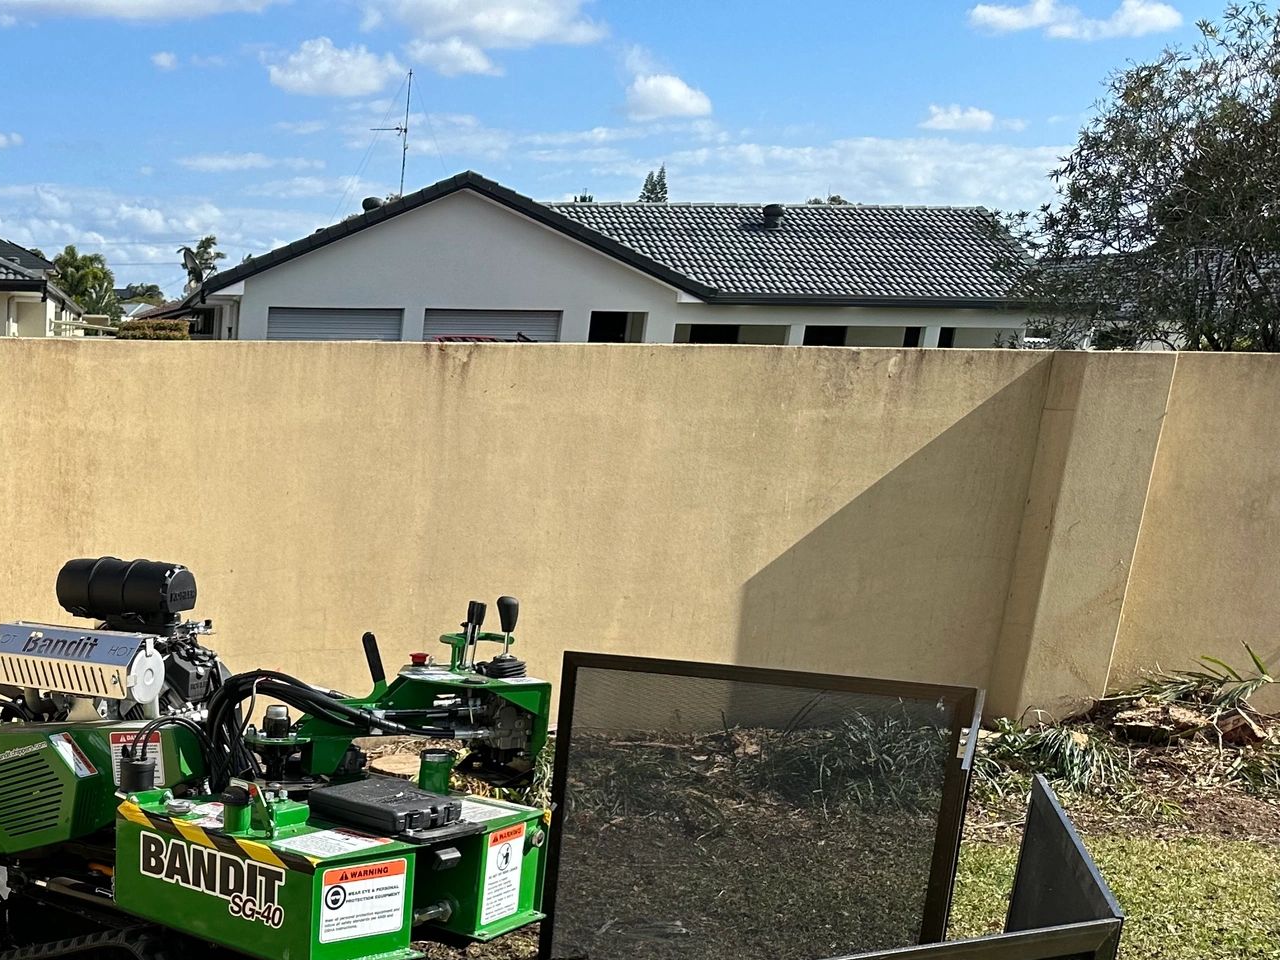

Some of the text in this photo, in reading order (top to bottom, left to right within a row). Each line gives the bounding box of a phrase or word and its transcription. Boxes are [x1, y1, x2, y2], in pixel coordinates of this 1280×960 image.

[22, 631, 98, 659] Bandit
[108, 646, 136, 657] HOT
[140, 831, 285, 910] BANDIT
[350, 866, 389, 878] WARNING
[375, 891, 401, 899] EQUIPMENT
[376, 884, 399, 892] PERSONAL
[229, 893, 284, 929] SG-40
